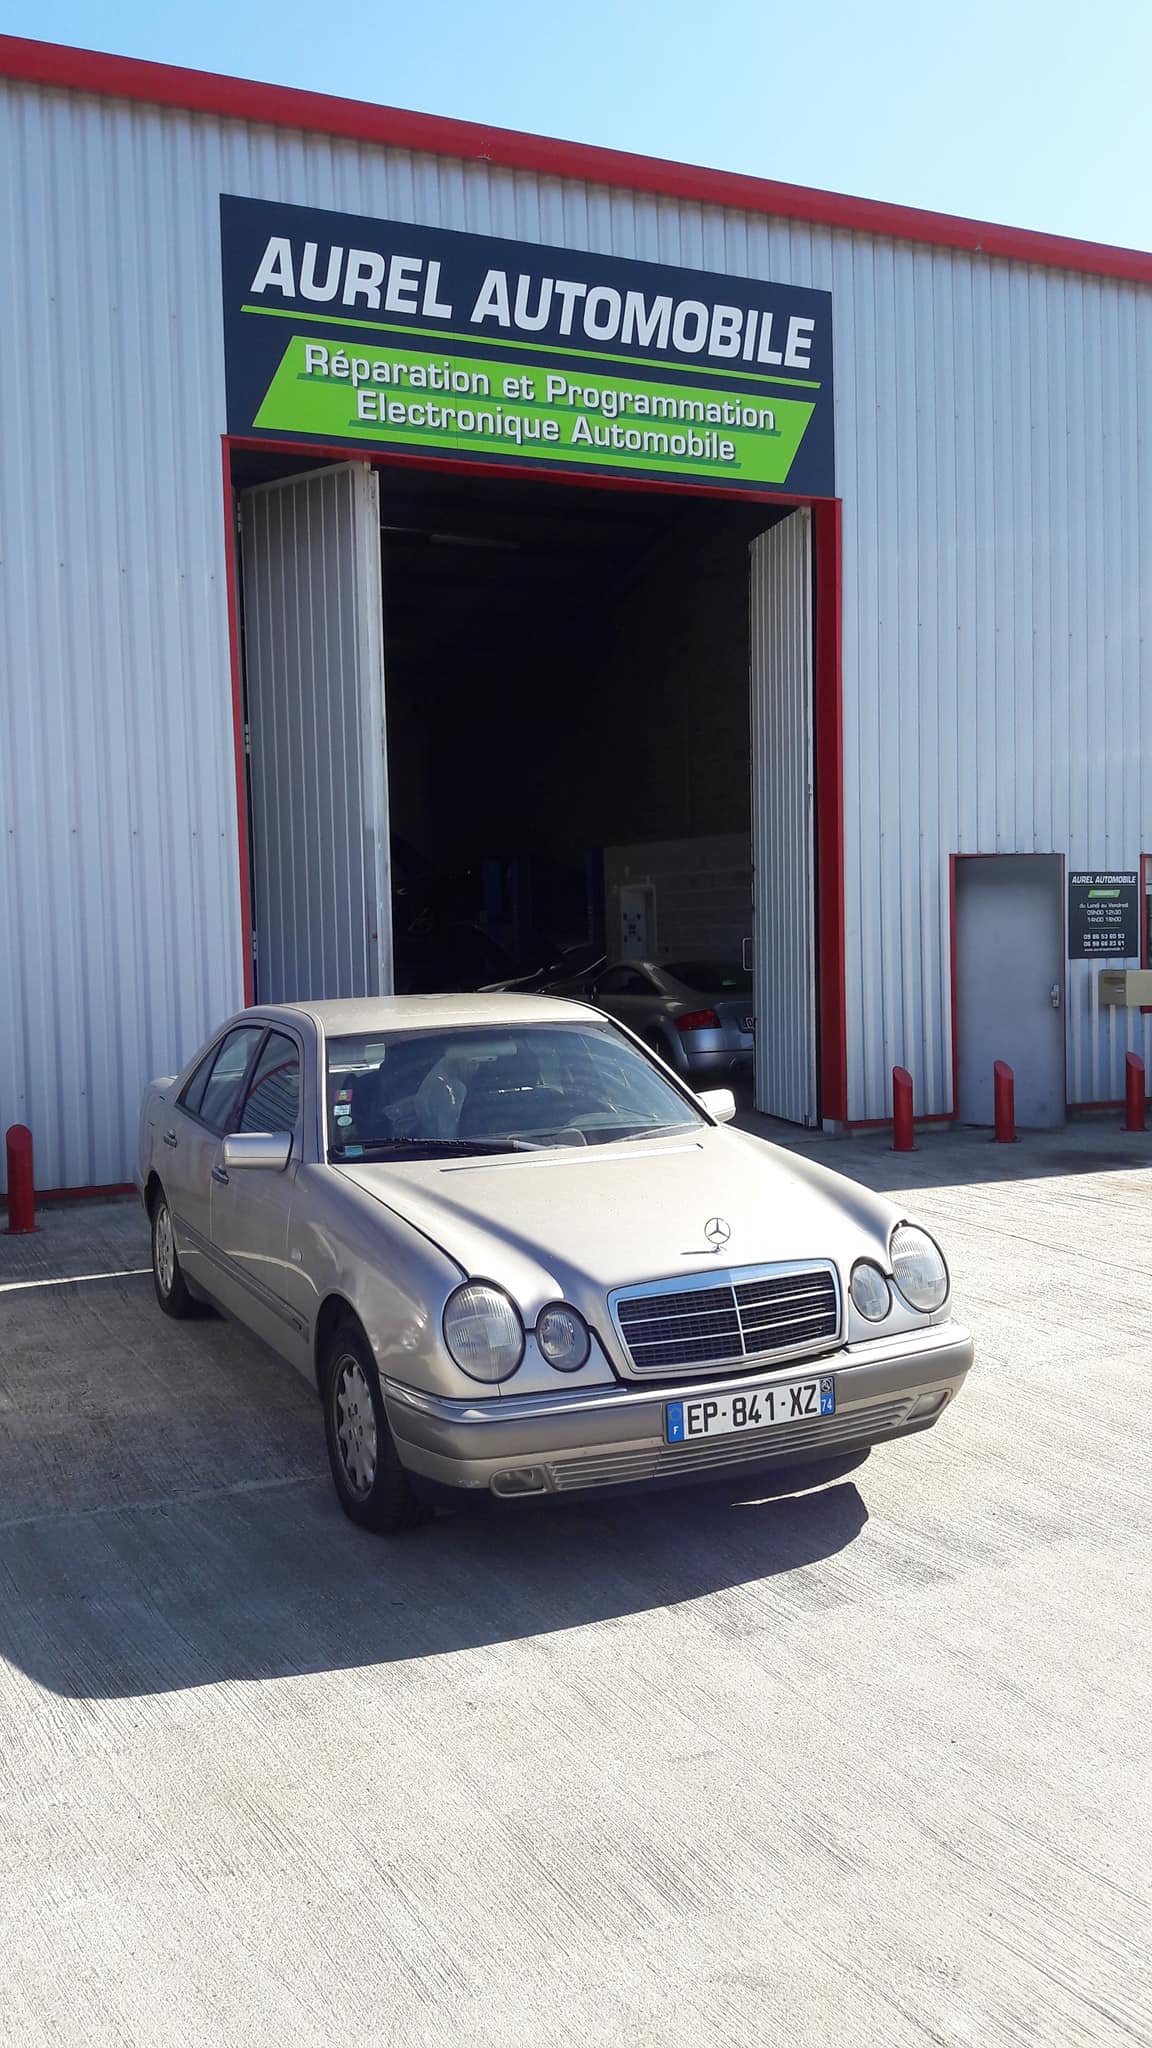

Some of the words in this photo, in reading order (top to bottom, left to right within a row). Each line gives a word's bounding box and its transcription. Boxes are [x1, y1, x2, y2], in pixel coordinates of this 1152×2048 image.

[250, 236, 452, 320] AUREL
[470, 269, 816, 370] AUTOMOBILE
[305, 344, 490, 397] Réparation
[502, 375, 535, 401] et
[546, 374, 776, 432] Programmation
[356, 389, 560, 444] Electronique
[571, 416, 736, 462] Automobile
[673, 1425, 679, 1435] F
[821, 1399, 833, 1412] 74
